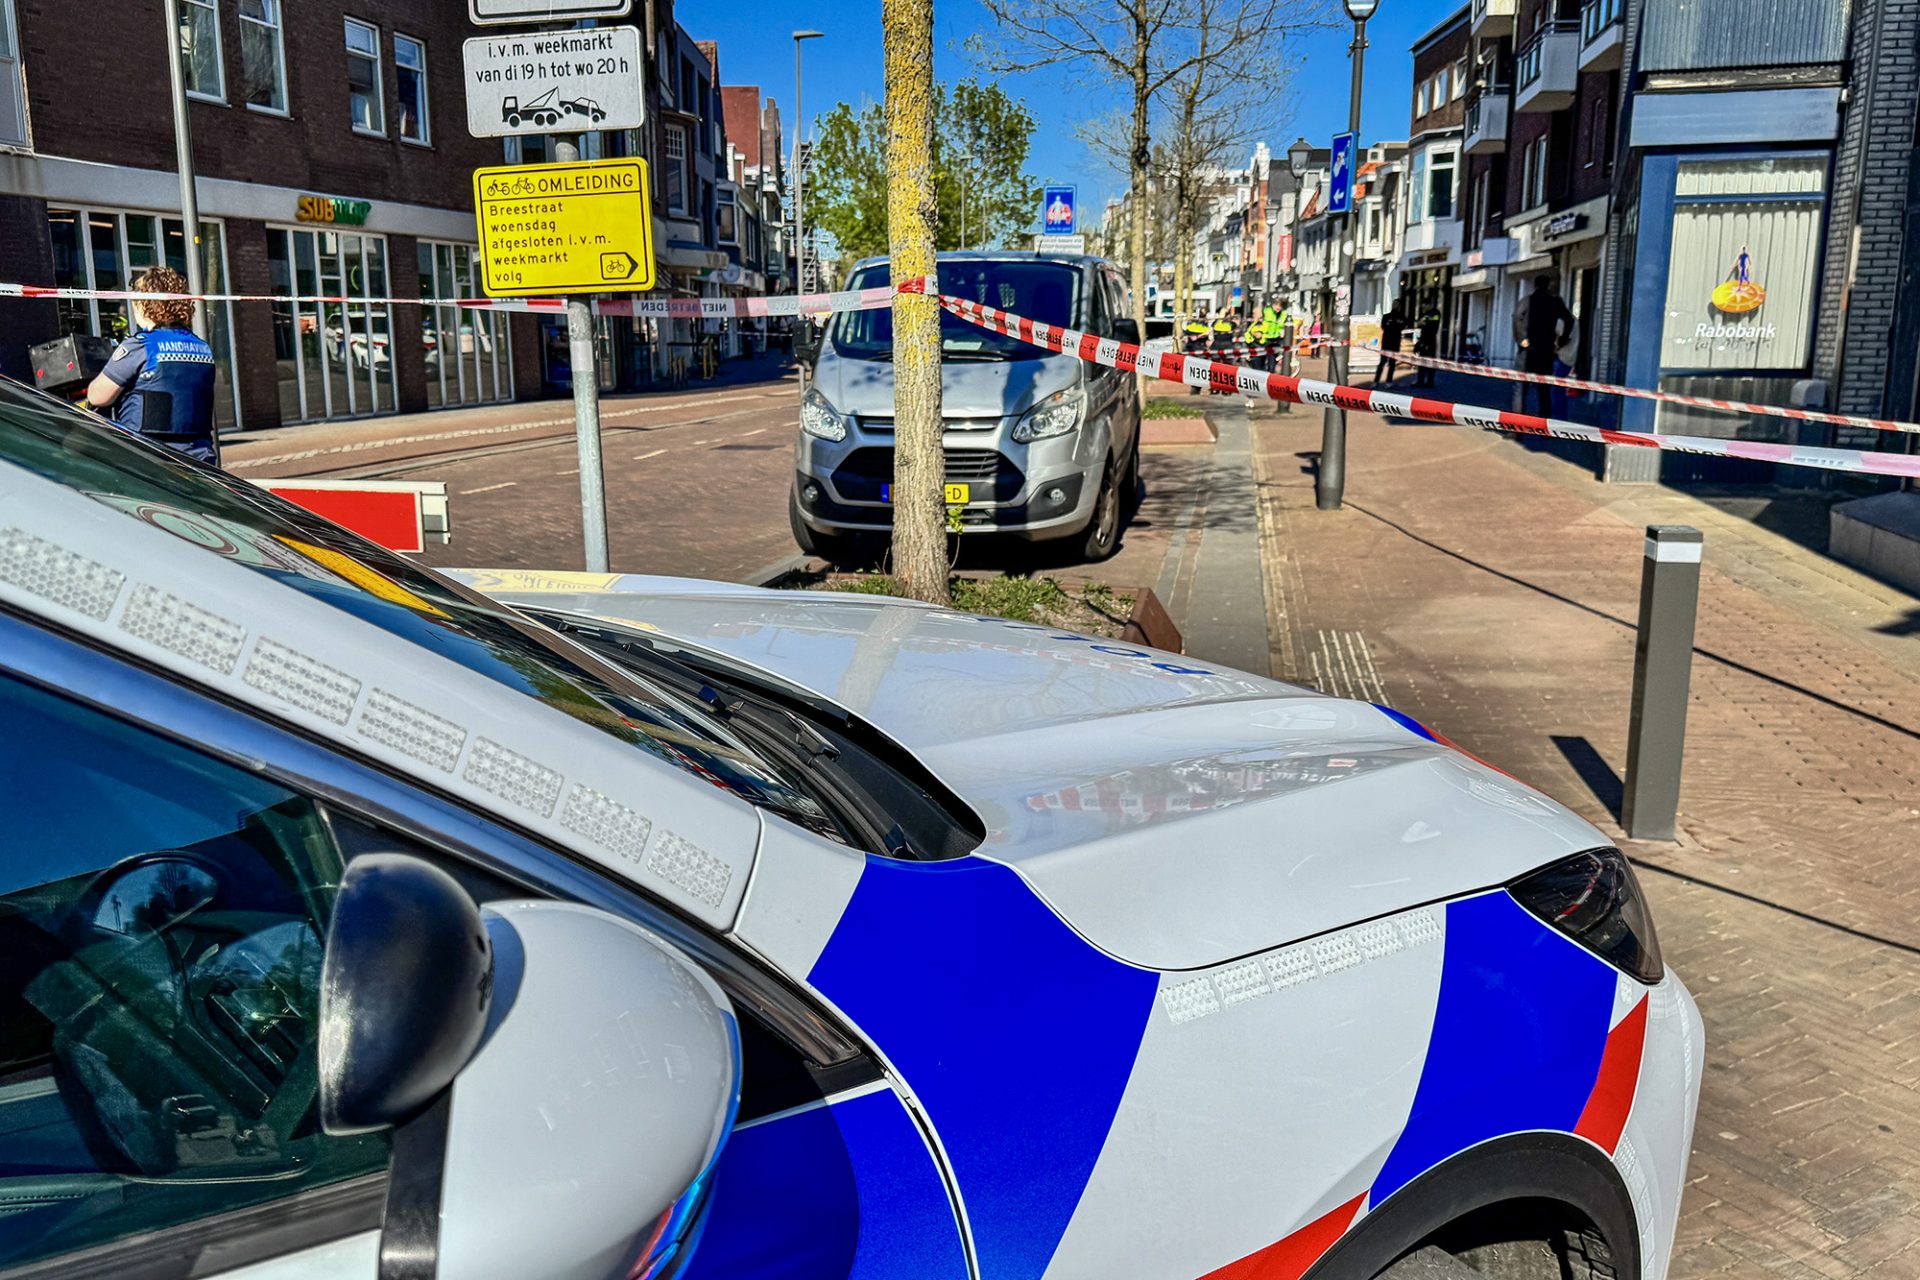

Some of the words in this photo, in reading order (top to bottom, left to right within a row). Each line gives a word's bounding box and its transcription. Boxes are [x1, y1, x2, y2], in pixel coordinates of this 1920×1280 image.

[488, 43, 529, 58] i.v.m.
[534, 33, 613, 54] weekmarkt
[475, 69, 501, 83] van
[505, 64, 518, 81] di
[521, 63, 534, 80] 19
[538, 62, 547, 79] h
[550, 61, 571, 78] tot
[575, 62, 594, 76] wo
[597, 57, 616, 75] 20
[620, 56, 629, 73] h
[538, 173, 633, 192] OMLEIDING
[489, 202, 563, 216] Breestraat
[491, 219, 556, 233] woensdag
[492, 236, 563, 252] afgesloten
[493, 251, 568, 265] weekmarkt
[495, 271, 522, 284] volg
[1695, 322, 1776, 338] Rabobank
[157, 341, 211, 353] HANDHAV
[1101, 346, 1136, 365] BETREDEN
[1137, 357, 1154, 369] NIET
[1189, 366, 1237, 387] BETREDEN
[1238, 371, 1260, 392] NIET
[1306, 390, 1371, 412] BETREDEN
[1373, 402, 1403, 416] NIET
